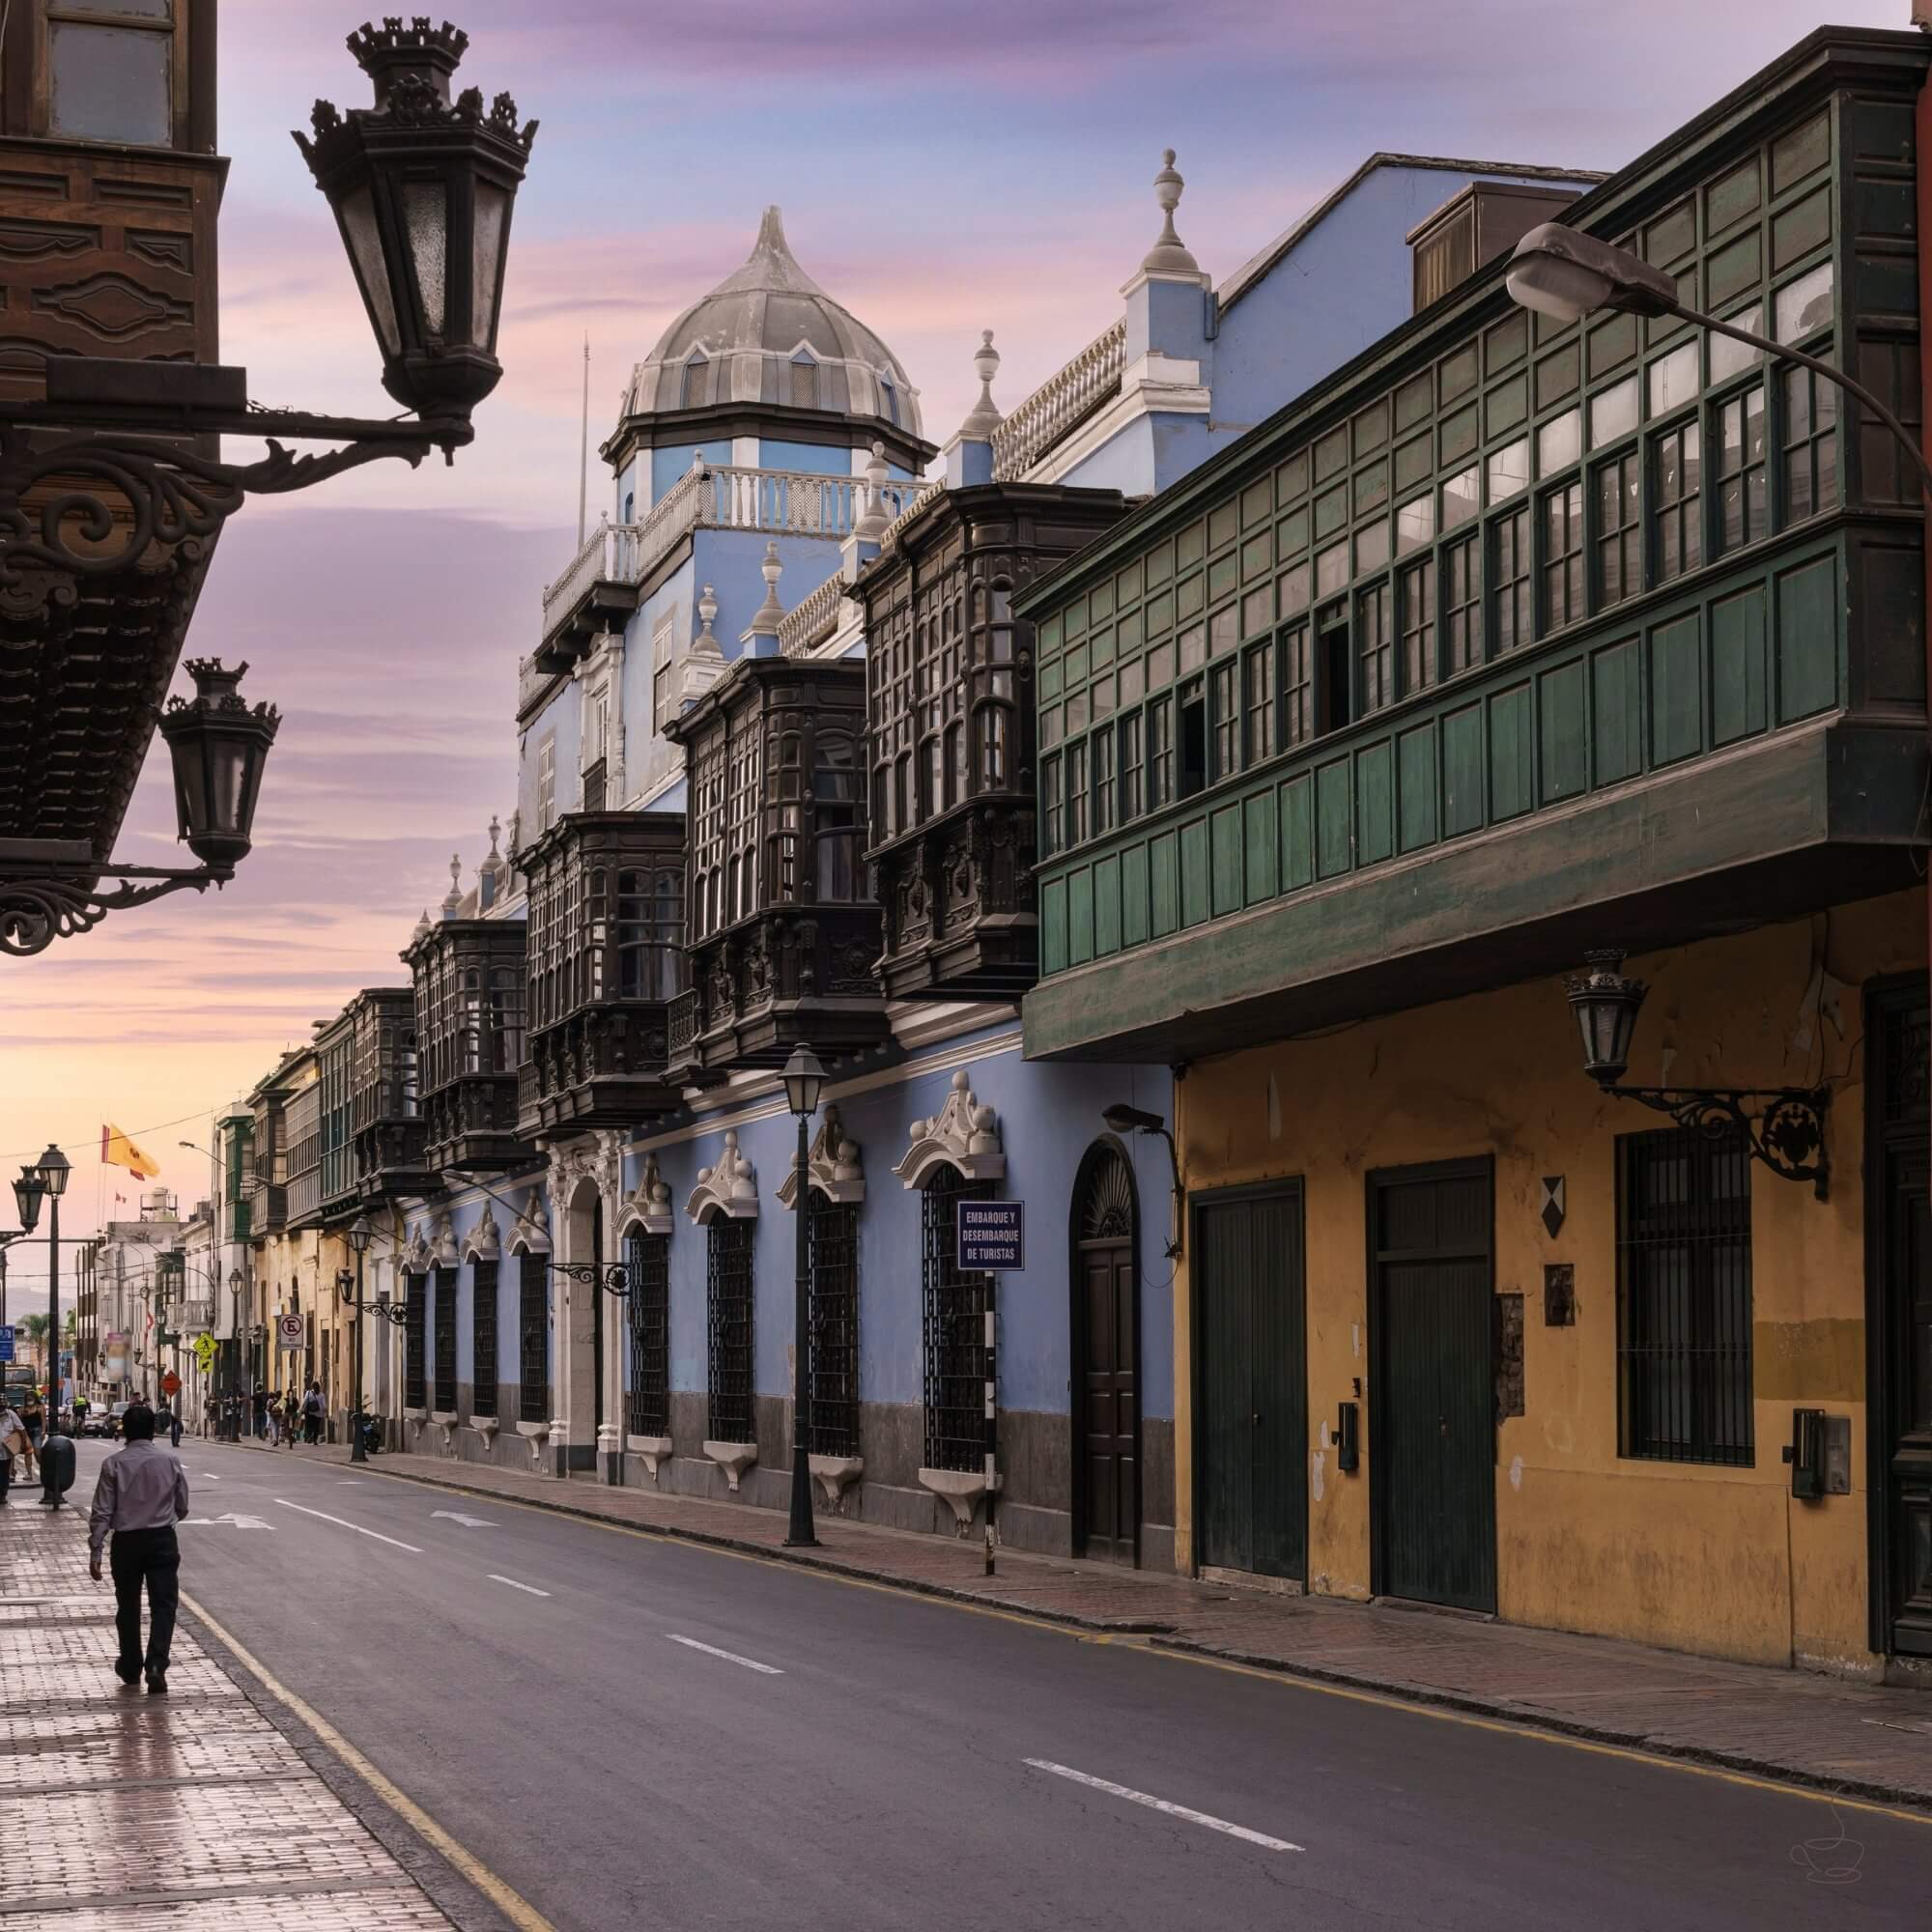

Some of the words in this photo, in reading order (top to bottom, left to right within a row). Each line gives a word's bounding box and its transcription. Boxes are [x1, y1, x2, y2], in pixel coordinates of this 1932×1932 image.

[966, 1211, 1009, 1225] EMBARQUE
[1009, 1211, 1015, 1223] Y
[962, 1230, 1019, 1242] DESEMBARQUE
[967, 1248, 978, 1260] DE
[979, 1248, 1014, 1260] TURISTAS
